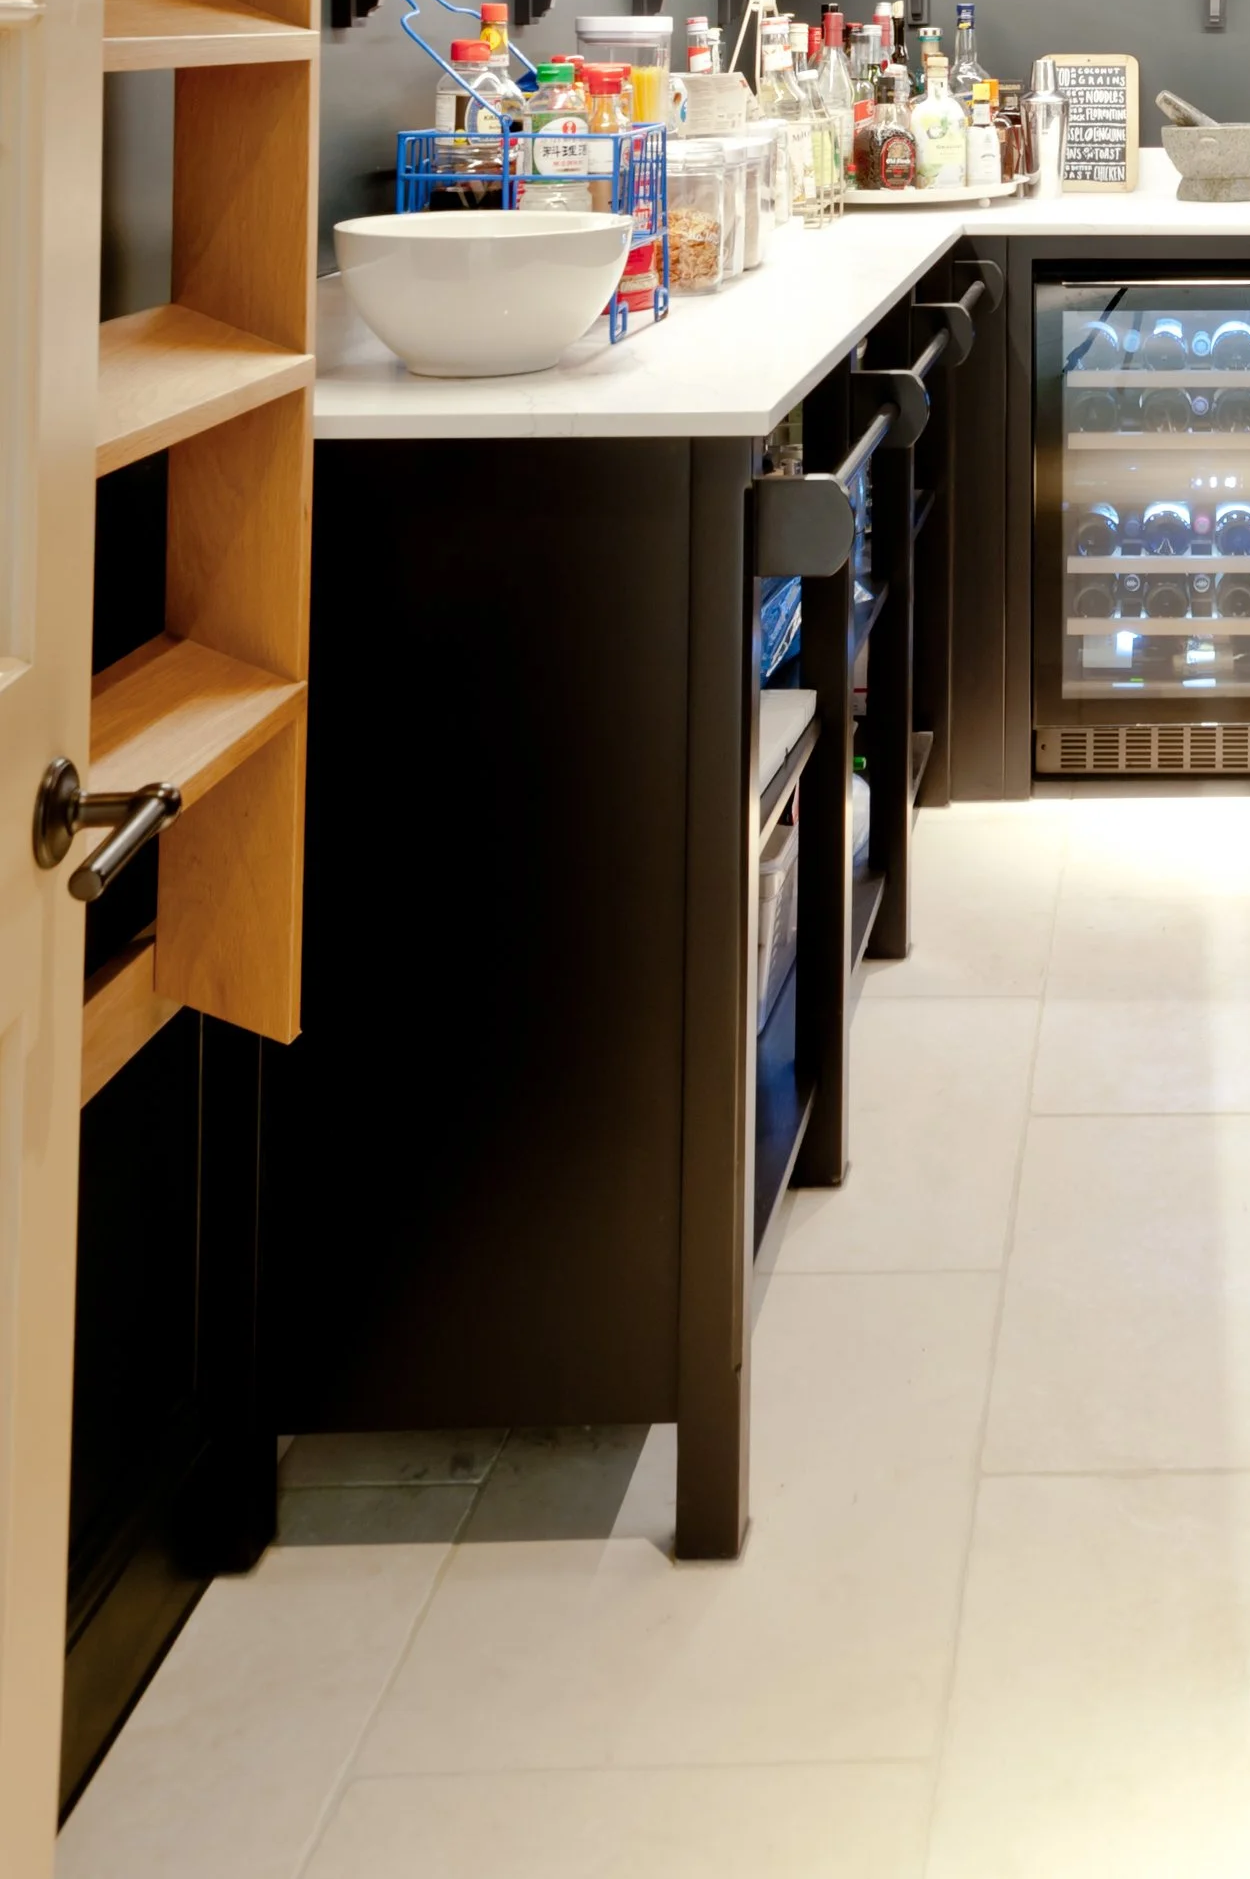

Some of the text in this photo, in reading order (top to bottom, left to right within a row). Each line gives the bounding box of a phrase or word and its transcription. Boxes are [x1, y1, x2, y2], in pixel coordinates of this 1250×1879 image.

[1078, 75, 1126, 87] GRAINS
[1085, 90, 1125, 104] NOODLES
[1095, 148, 1121, 160] TOAST
[1093, 165, 1126, 182] CHICKEN
